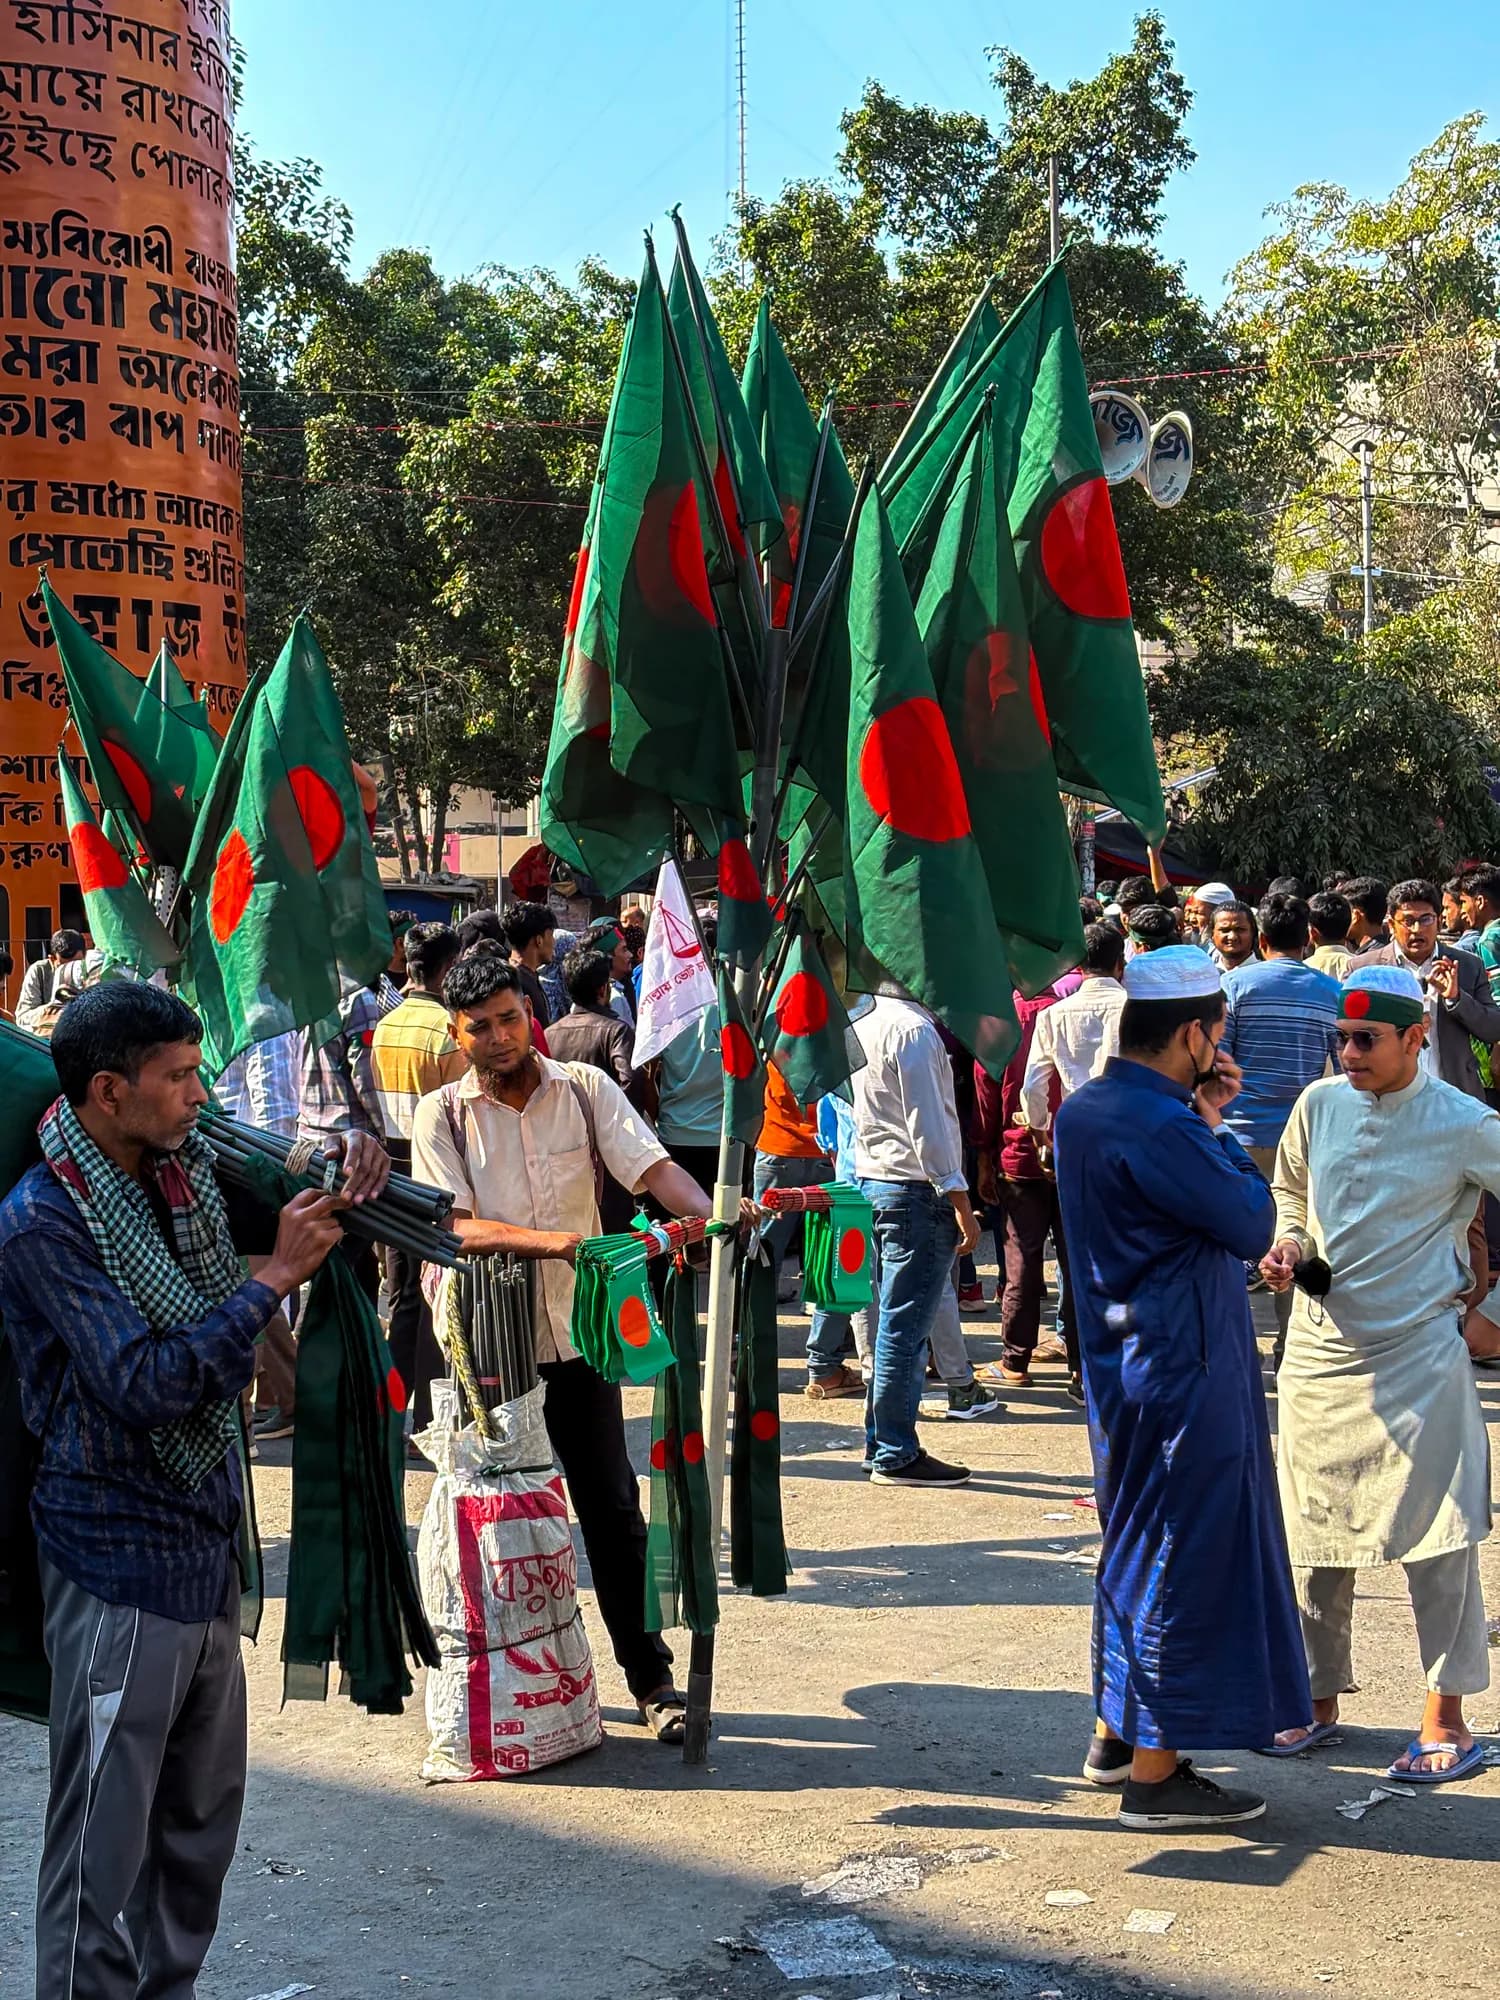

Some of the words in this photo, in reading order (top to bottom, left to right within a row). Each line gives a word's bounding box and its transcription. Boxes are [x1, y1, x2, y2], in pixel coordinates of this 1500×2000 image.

[117, 76, 220, 144] রাখবো
[131, 141, 223, 209] পোলার
[0, 264, 128, 331] ানো
[109, 402, 184, 455] বাপ
[154, 491, 234, 538] অনেক
[2, 660, 70, 709] বিপ্ল
